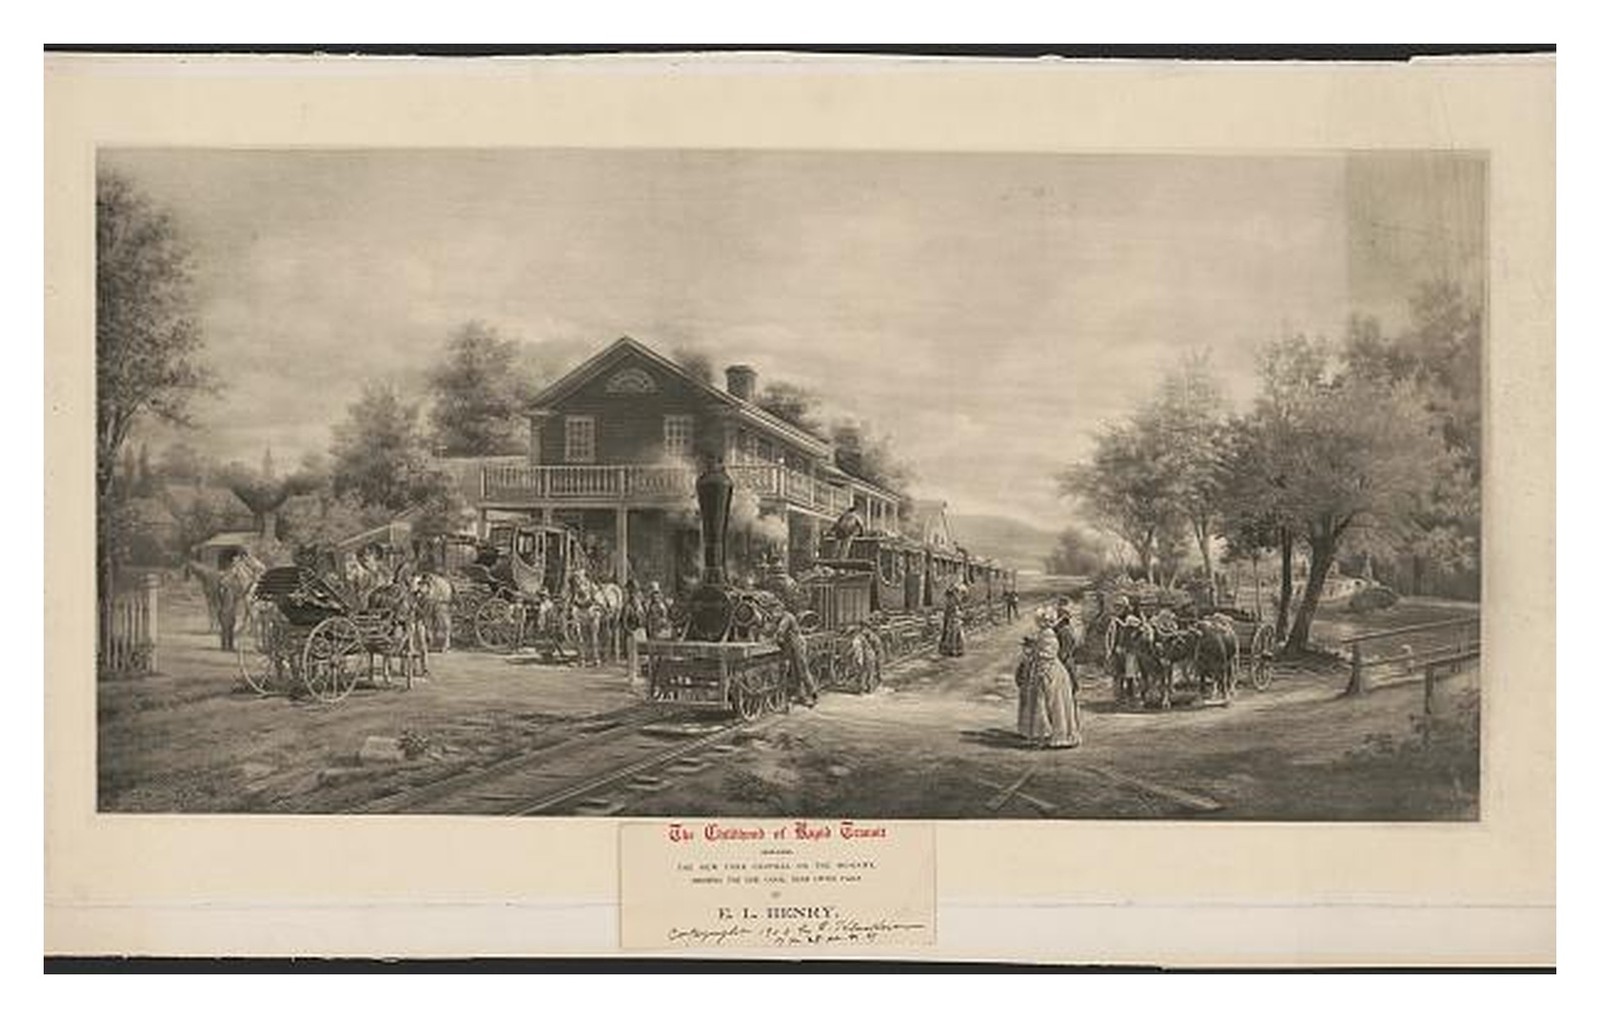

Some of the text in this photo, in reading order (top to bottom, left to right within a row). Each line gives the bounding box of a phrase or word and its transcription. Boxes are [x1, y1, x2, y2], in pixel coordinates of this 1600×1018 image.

[668, 824, 694, 842] The
[774, 827, 787, 840] of
[718, 907, 840, 919] E. L. HENRY.
